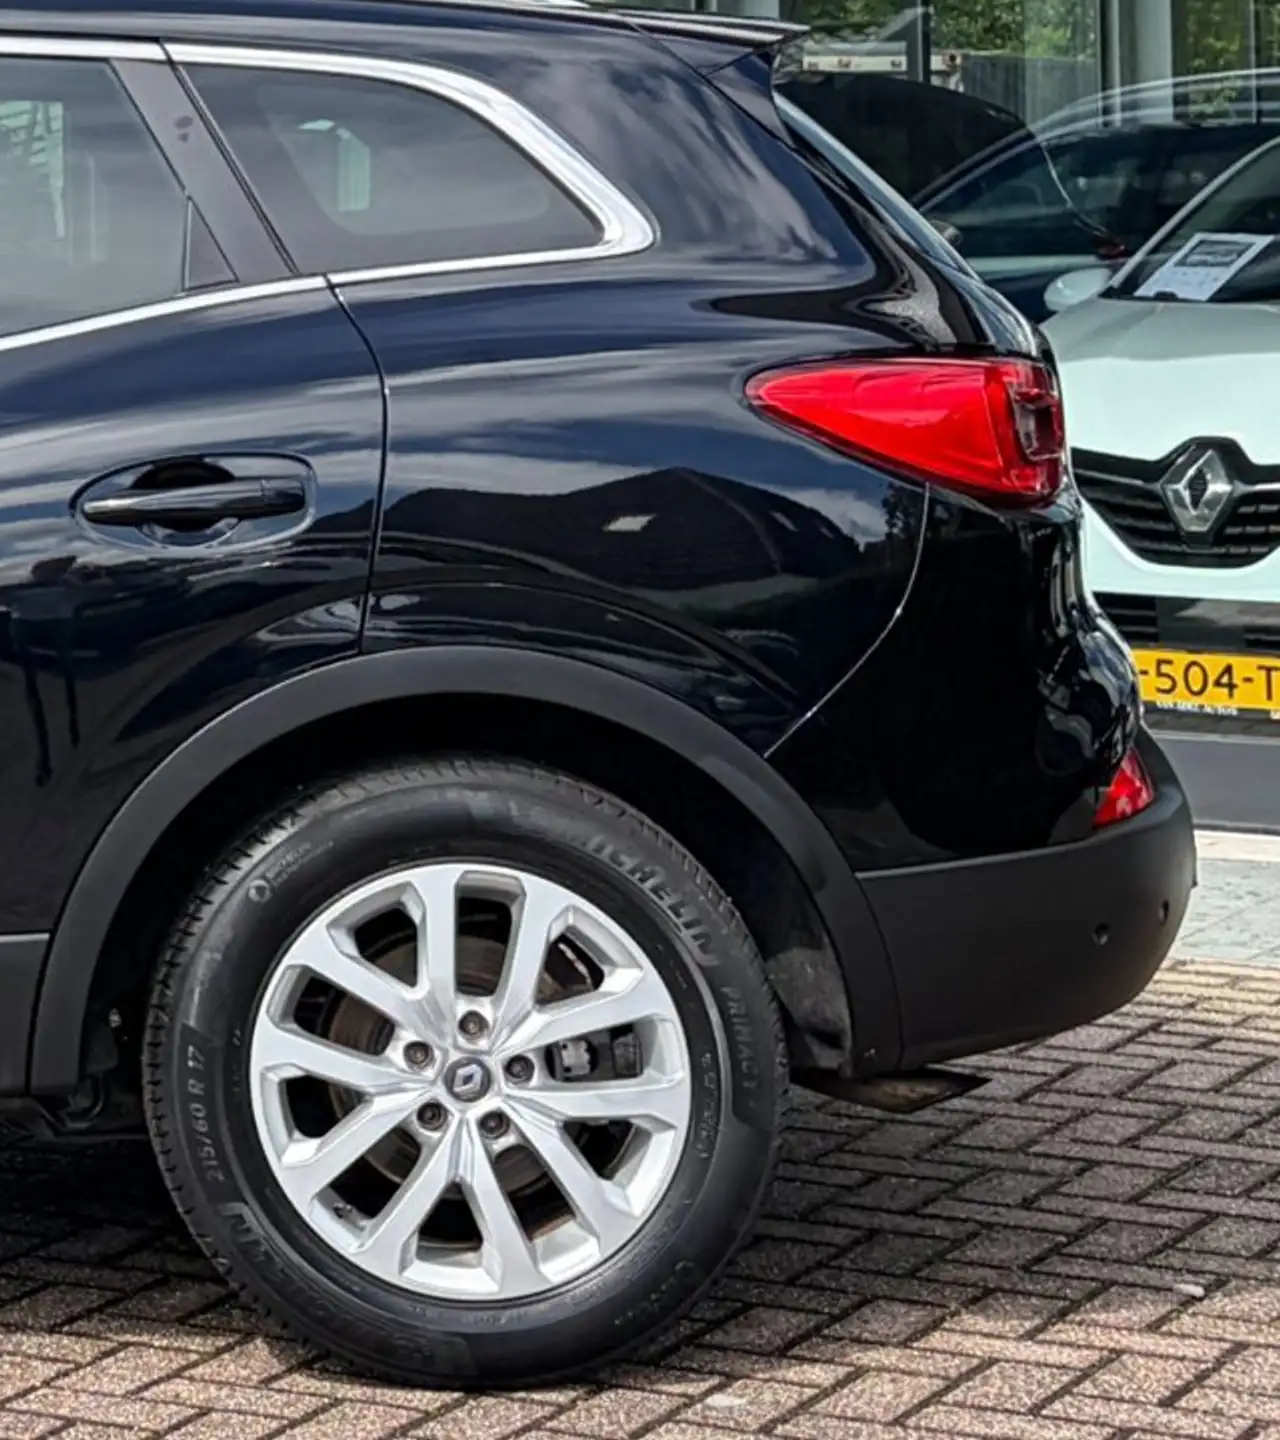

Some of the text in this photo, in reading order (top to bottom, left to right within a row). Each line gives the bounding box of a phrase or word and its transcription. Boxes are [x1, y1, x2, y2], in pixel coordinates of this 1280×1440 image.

[562, 812, 721, 955] ICHELIN
[187, 1044, 225, 1183] 215/60 R 17
